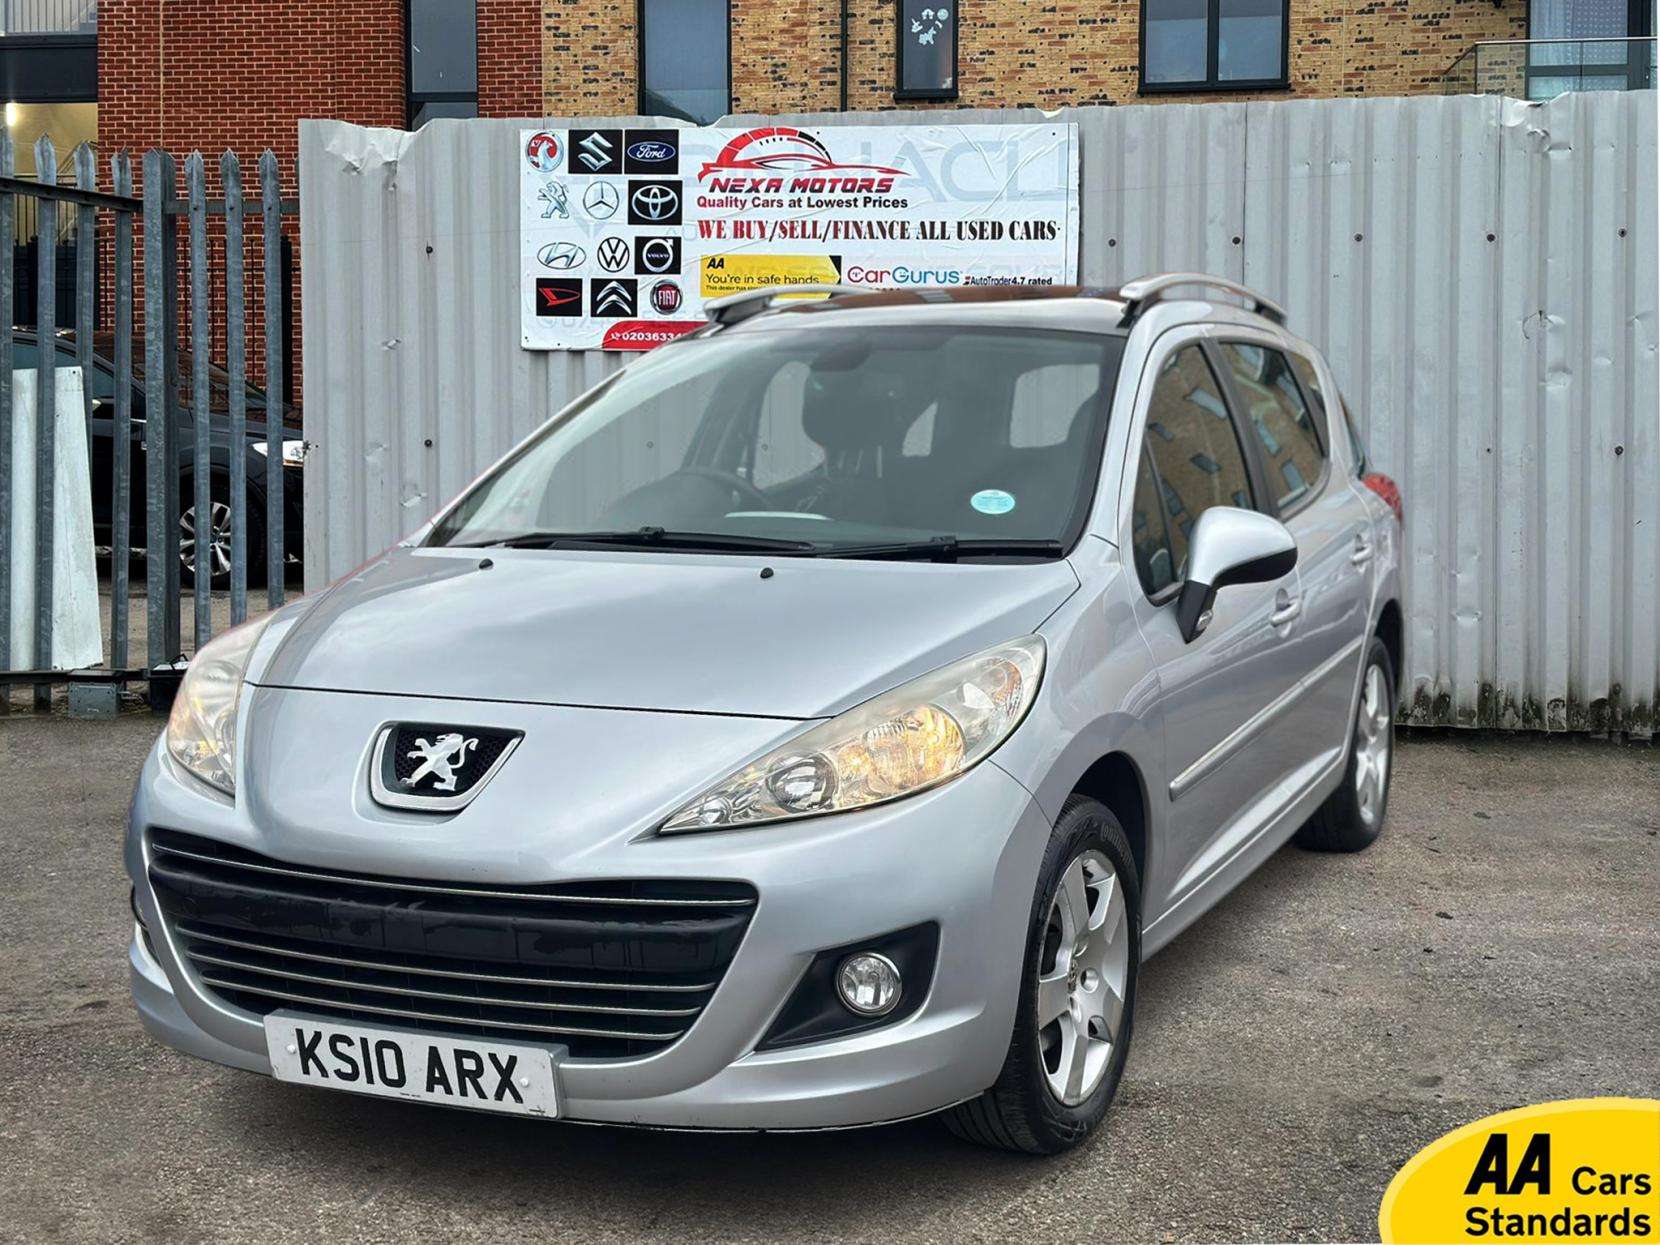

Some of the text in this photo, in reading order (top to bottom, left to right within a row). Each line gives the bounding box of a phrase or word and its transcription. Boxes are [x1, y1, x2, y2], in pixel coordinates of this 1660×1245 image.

[636, 145, 666, 158] Ford
[709, 178, 894, 193] NEXA MOTORS
[697, 196, 908, 210] Quality Cars at Lowest Prices
[698, 220, 726, 240] WE
[733, 220, 911, 243] BUY/SELL/FINANCE
[916, 220, 951, 240] ALL
[956, 220, 1003, 240] USED
[1009, 220, 1056, 240] CARS
[707, 257, 725, 269] AA
[706, 273, 819, 284] You're in safe hands
[848, 266, 960, 283] CarGurus
[1028, 277, 1052, 285] rated
[658, 290, 676, 305] FIAT
[425, 1045, 523, 1104] ARX
